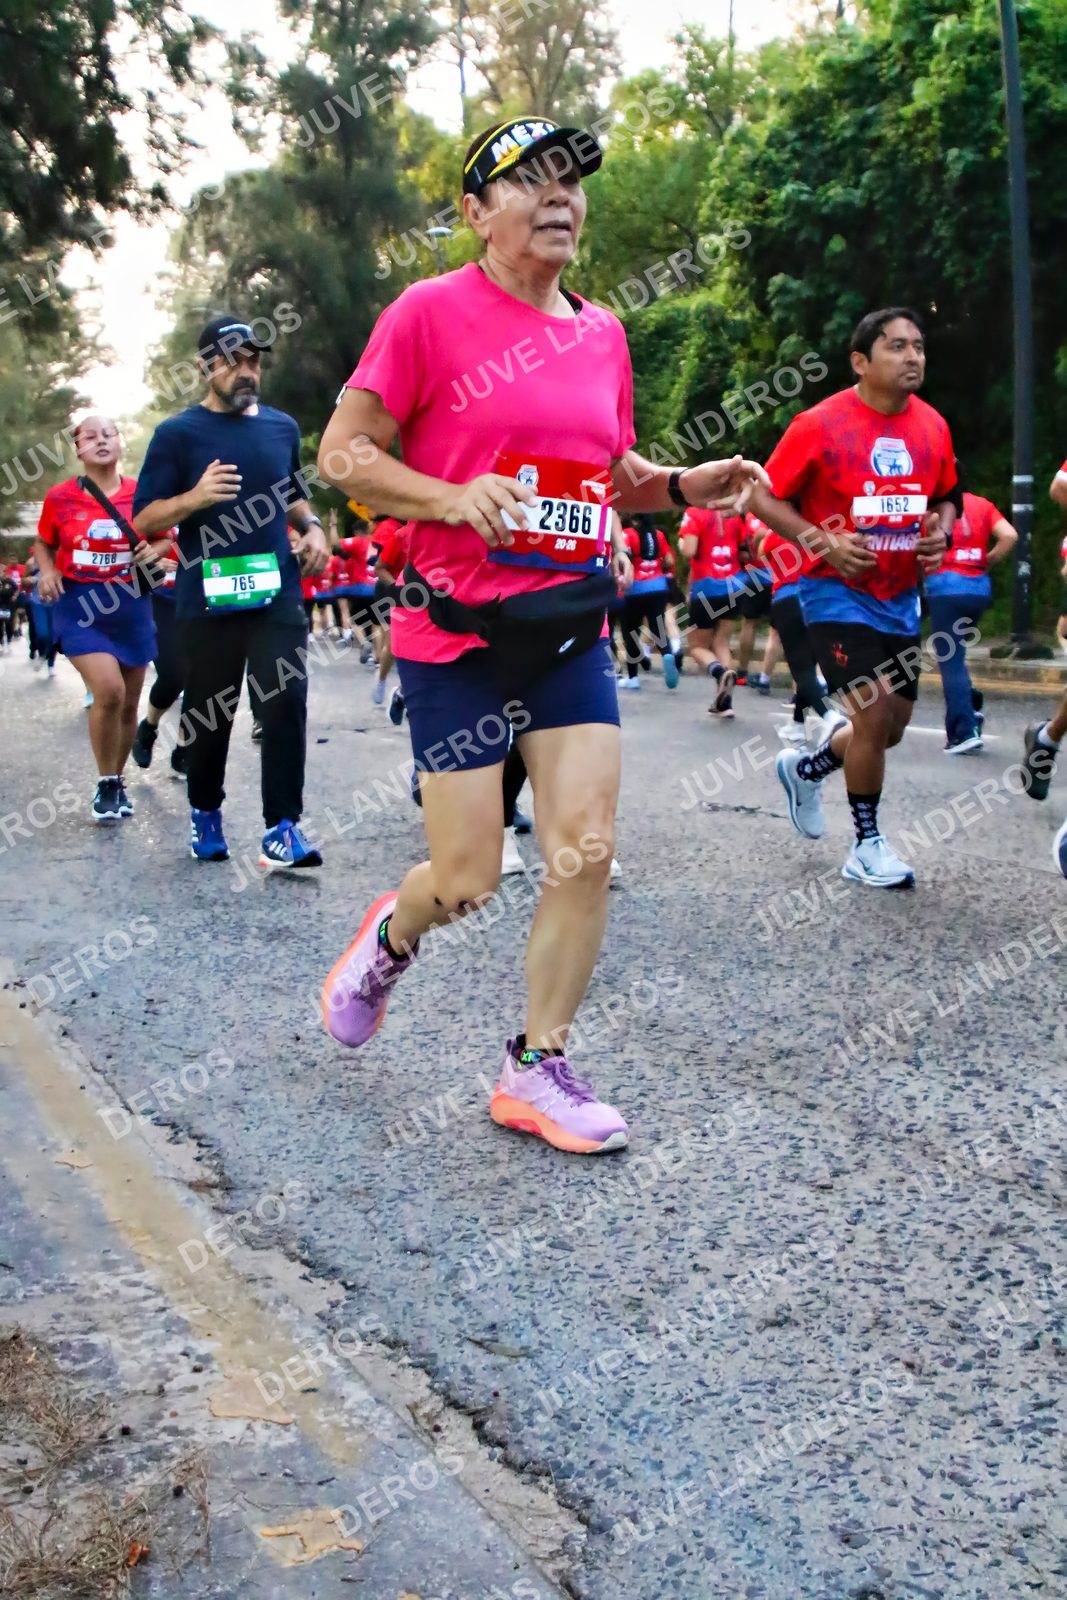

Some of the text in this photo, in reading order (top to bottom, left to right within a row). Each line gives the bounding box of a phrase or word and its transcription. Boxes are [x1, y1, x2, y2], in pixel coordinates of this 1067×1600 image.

[881, 497, 909, 512] 1652
[539, 500, 592, 535] 2366
[232, 576, 255, 591] 765
